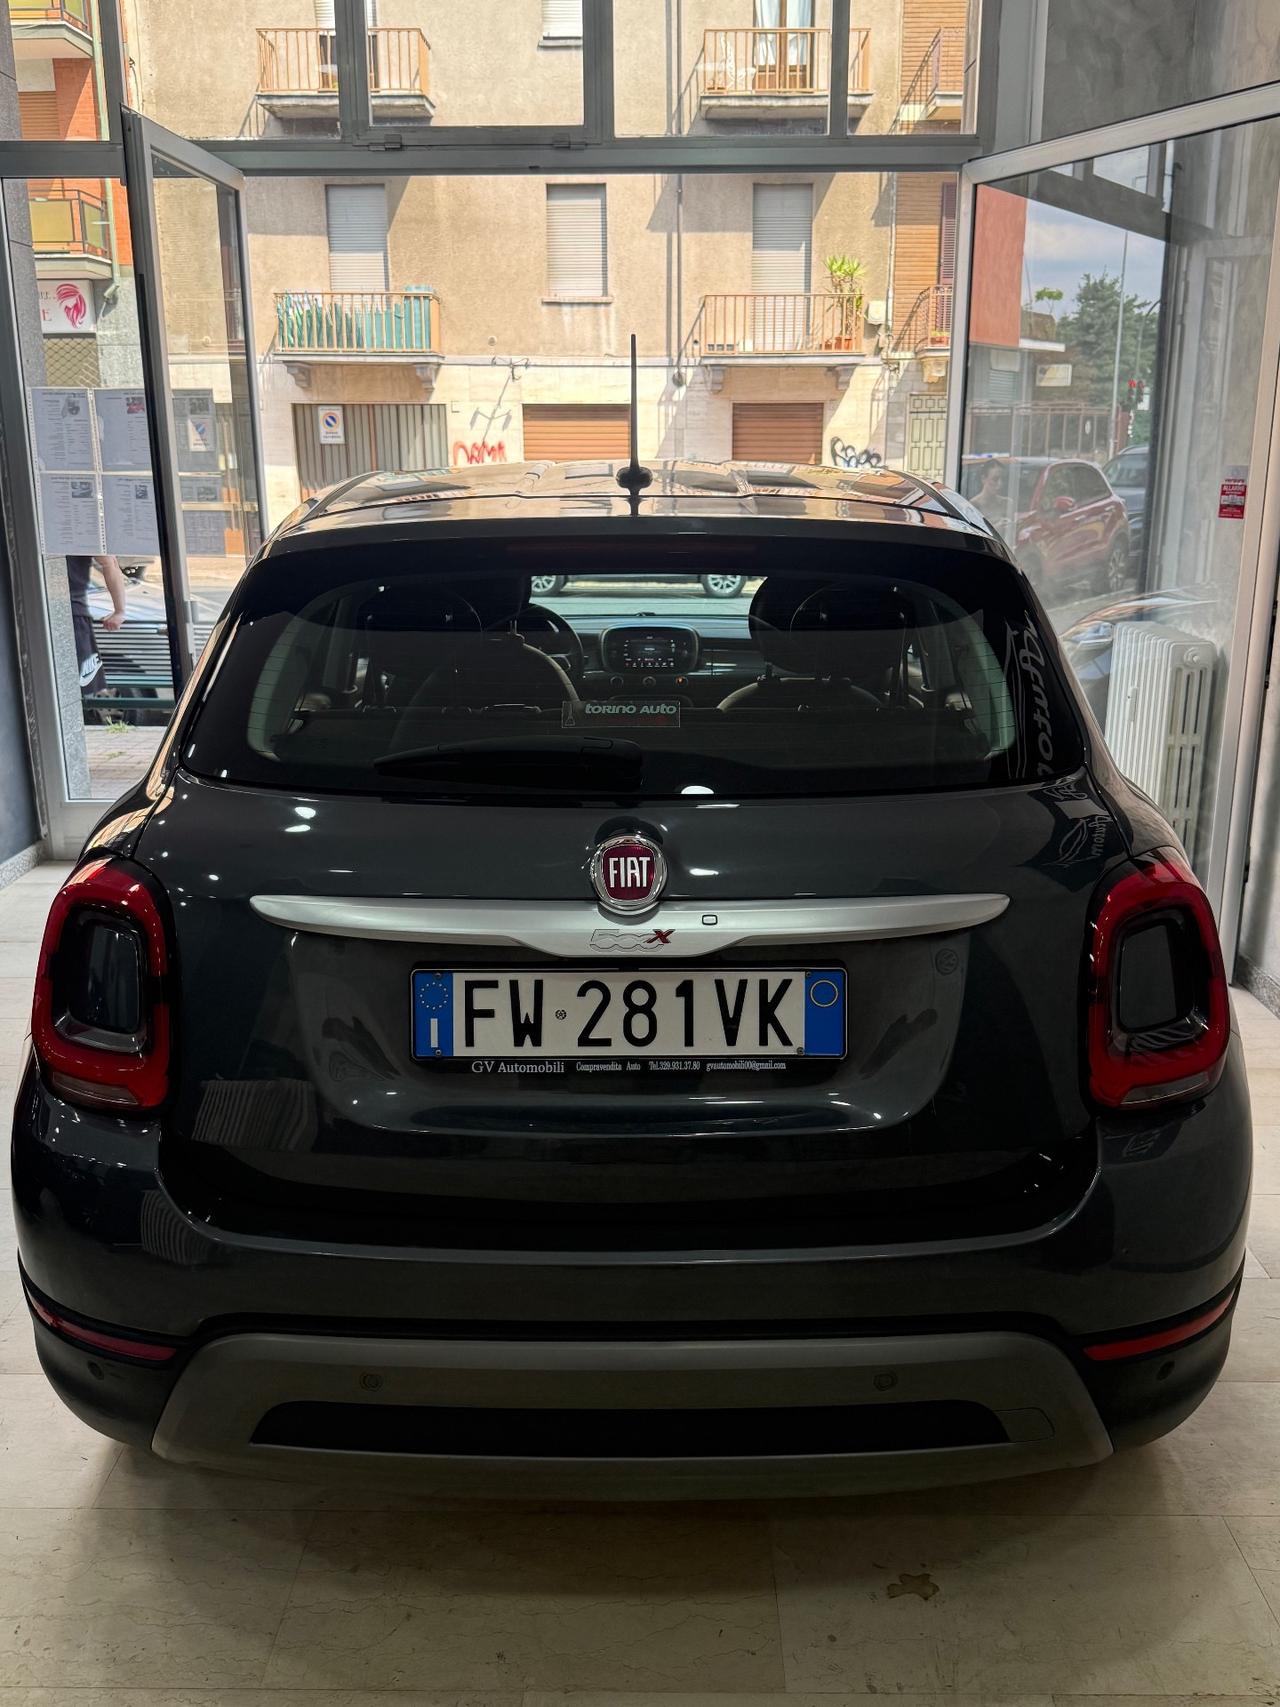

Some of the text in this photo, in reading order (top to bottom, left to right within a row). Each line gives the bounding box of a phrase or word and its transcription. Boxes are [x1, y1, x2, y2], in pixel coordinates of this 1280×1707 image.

[609, 857, 651, 888] FIAT
[589, 928, 676, 953] 500X
[464, 979, 794, 1048] FW 281VK
[471, 1059, 565, 1073] GV Automobili
[575, 1060, 622, 1073] Compravendita
[626, 1061, 641, 1071] Auto
